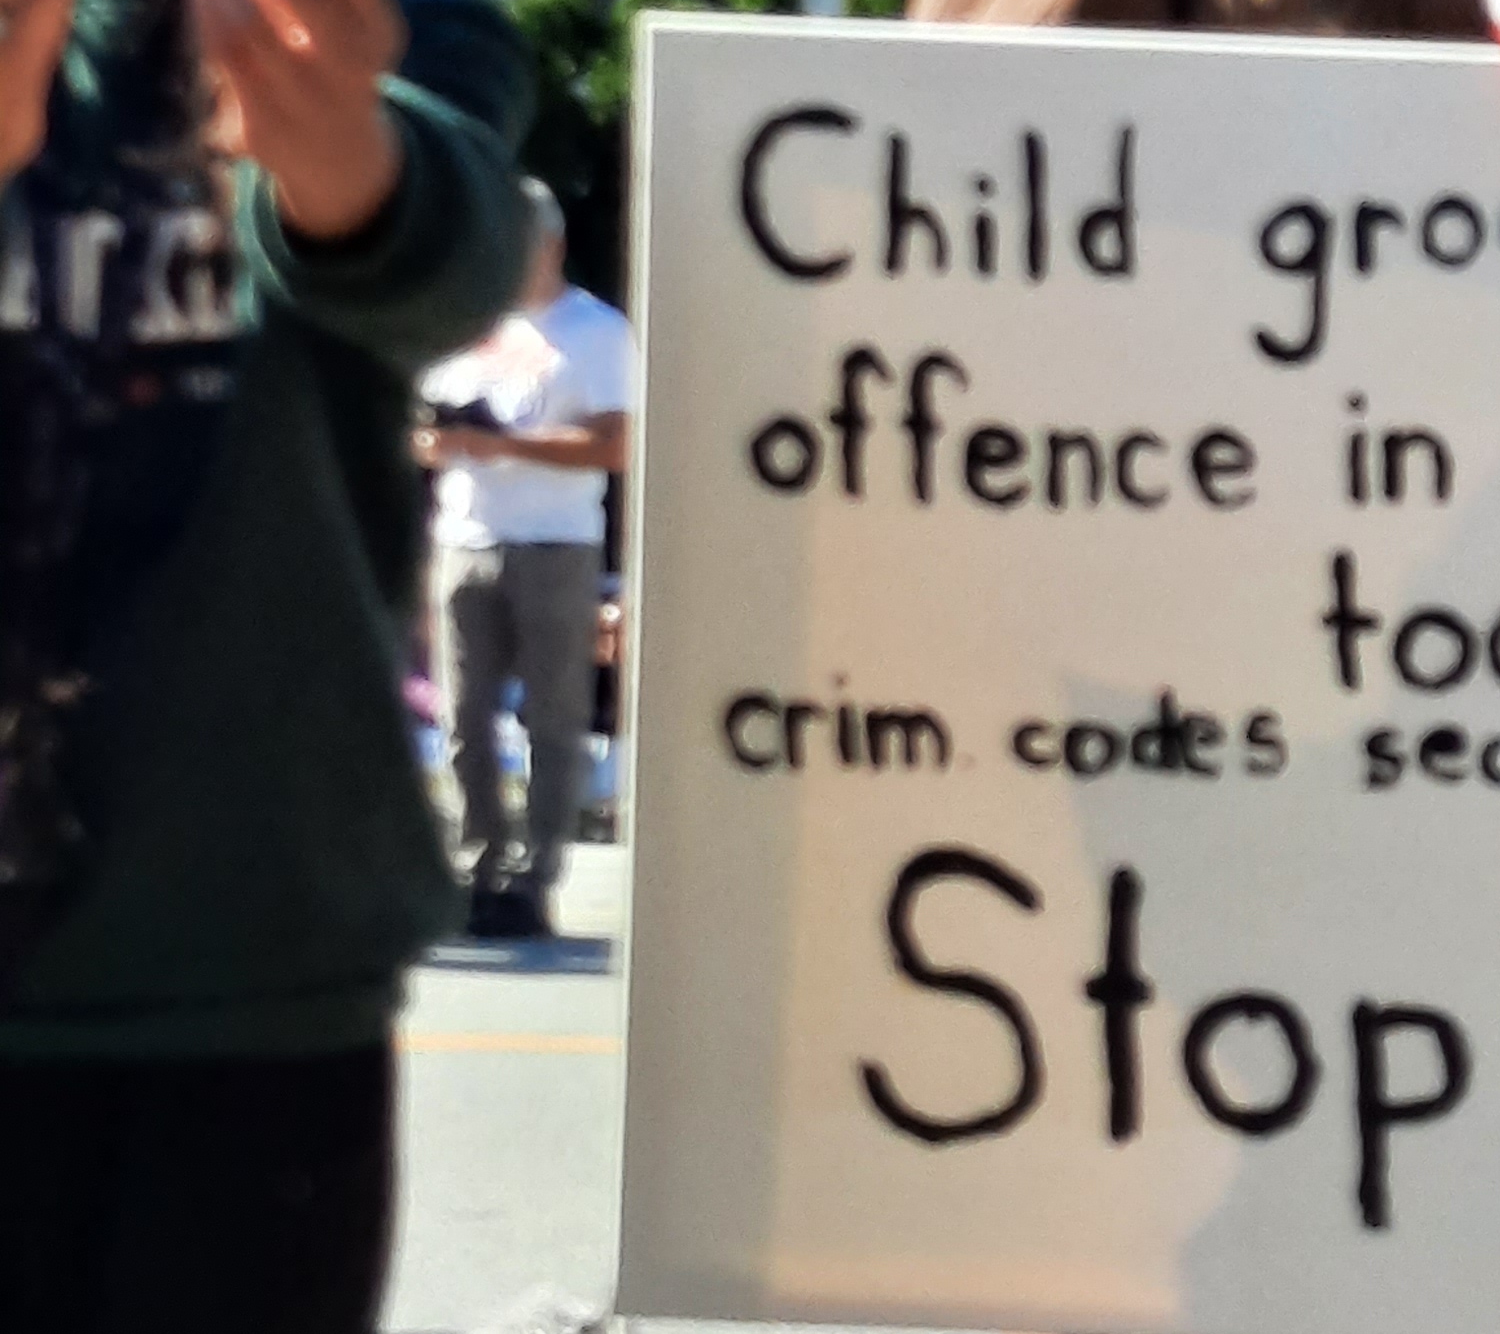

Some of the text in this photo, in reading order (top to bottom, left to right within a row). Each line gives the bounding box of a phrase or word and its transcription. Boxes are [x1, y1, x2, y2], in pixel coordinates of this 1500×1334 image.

[736, 104, 1134, 284] Child
[749, 346, 1258, 509] offence
[1347, 395, 1452, 504] in
[1010, 692, 1286, 779] codes
[858, 845, 1471, 1232] Stop
